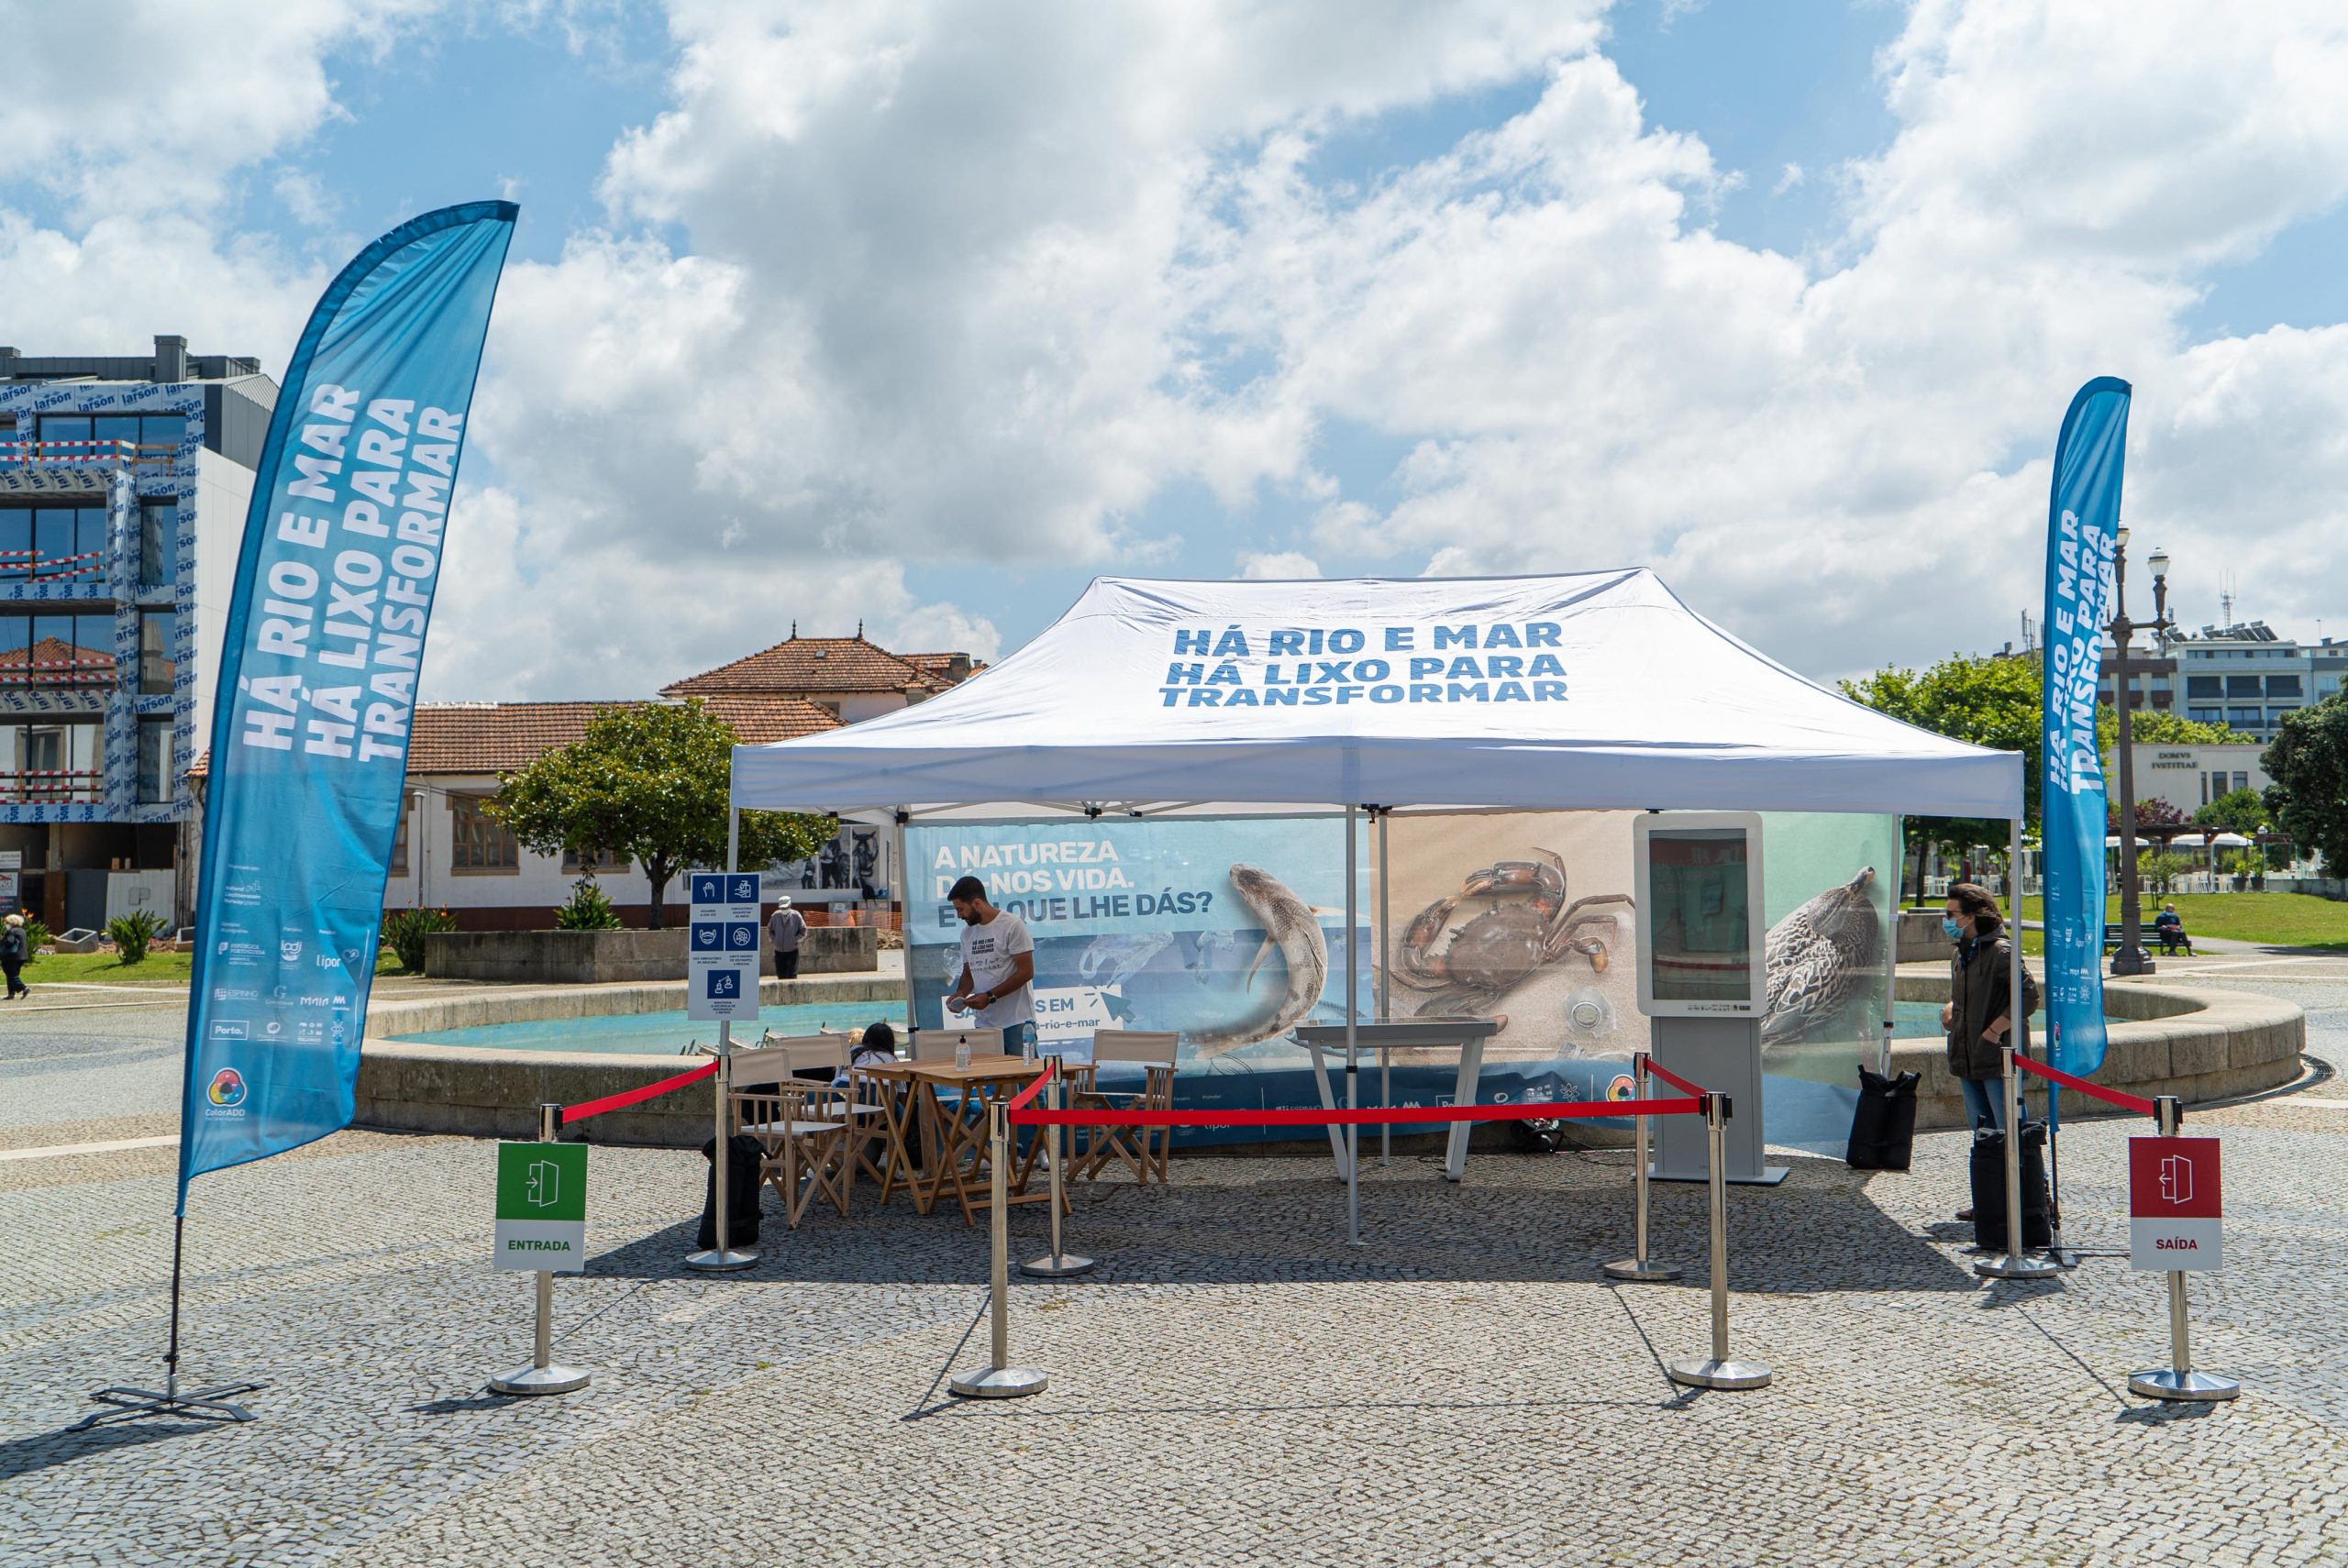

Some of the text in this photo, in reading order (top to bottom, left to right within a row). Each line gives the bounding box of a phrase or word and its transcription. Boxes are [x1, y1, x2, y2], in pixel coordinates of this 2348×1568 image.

[34, 392, 72, 410] larson
[77, 395, 116, 412] larson
[121, 386, 159, 404] larson
[238, 383, 360, 750] HÁ RIO E MAR
[2057, 510, 2079, 602] MAR
[301, 398, 415, 759] HÁ LIXO PARA
[358, 406, 463, 762] TRANSFORMAR
[2077, 525, 2101, 630] PARA
[2055, 607, 2074, 636] E
[1174, 622, 1564, 657] HÁ RIO E MAR
[1165, 654, 1567, 686] HÁ LIXO PARA
[2052, 644, 2068, 717] RIO
[135, 695, 172, 714] larson
[1158, 680, 1568, 708] TRANSFORMAR
[934, 840, 1120, 869] A NATUREZA
[936, 867, 1135, 900] D-NOS VIDA.
[938, 887, 1213, 928] E QUE LHE DÁS?
[1050, 997, 1075, 1012] EM
[215, 1025, 244, 1035] Porto.
[205, 1109, 246, 1117] ColorADD
[508, 1240, 570, 1252] ENTRADA
[2155, 1236, 2198, 1250] SAÍDA
